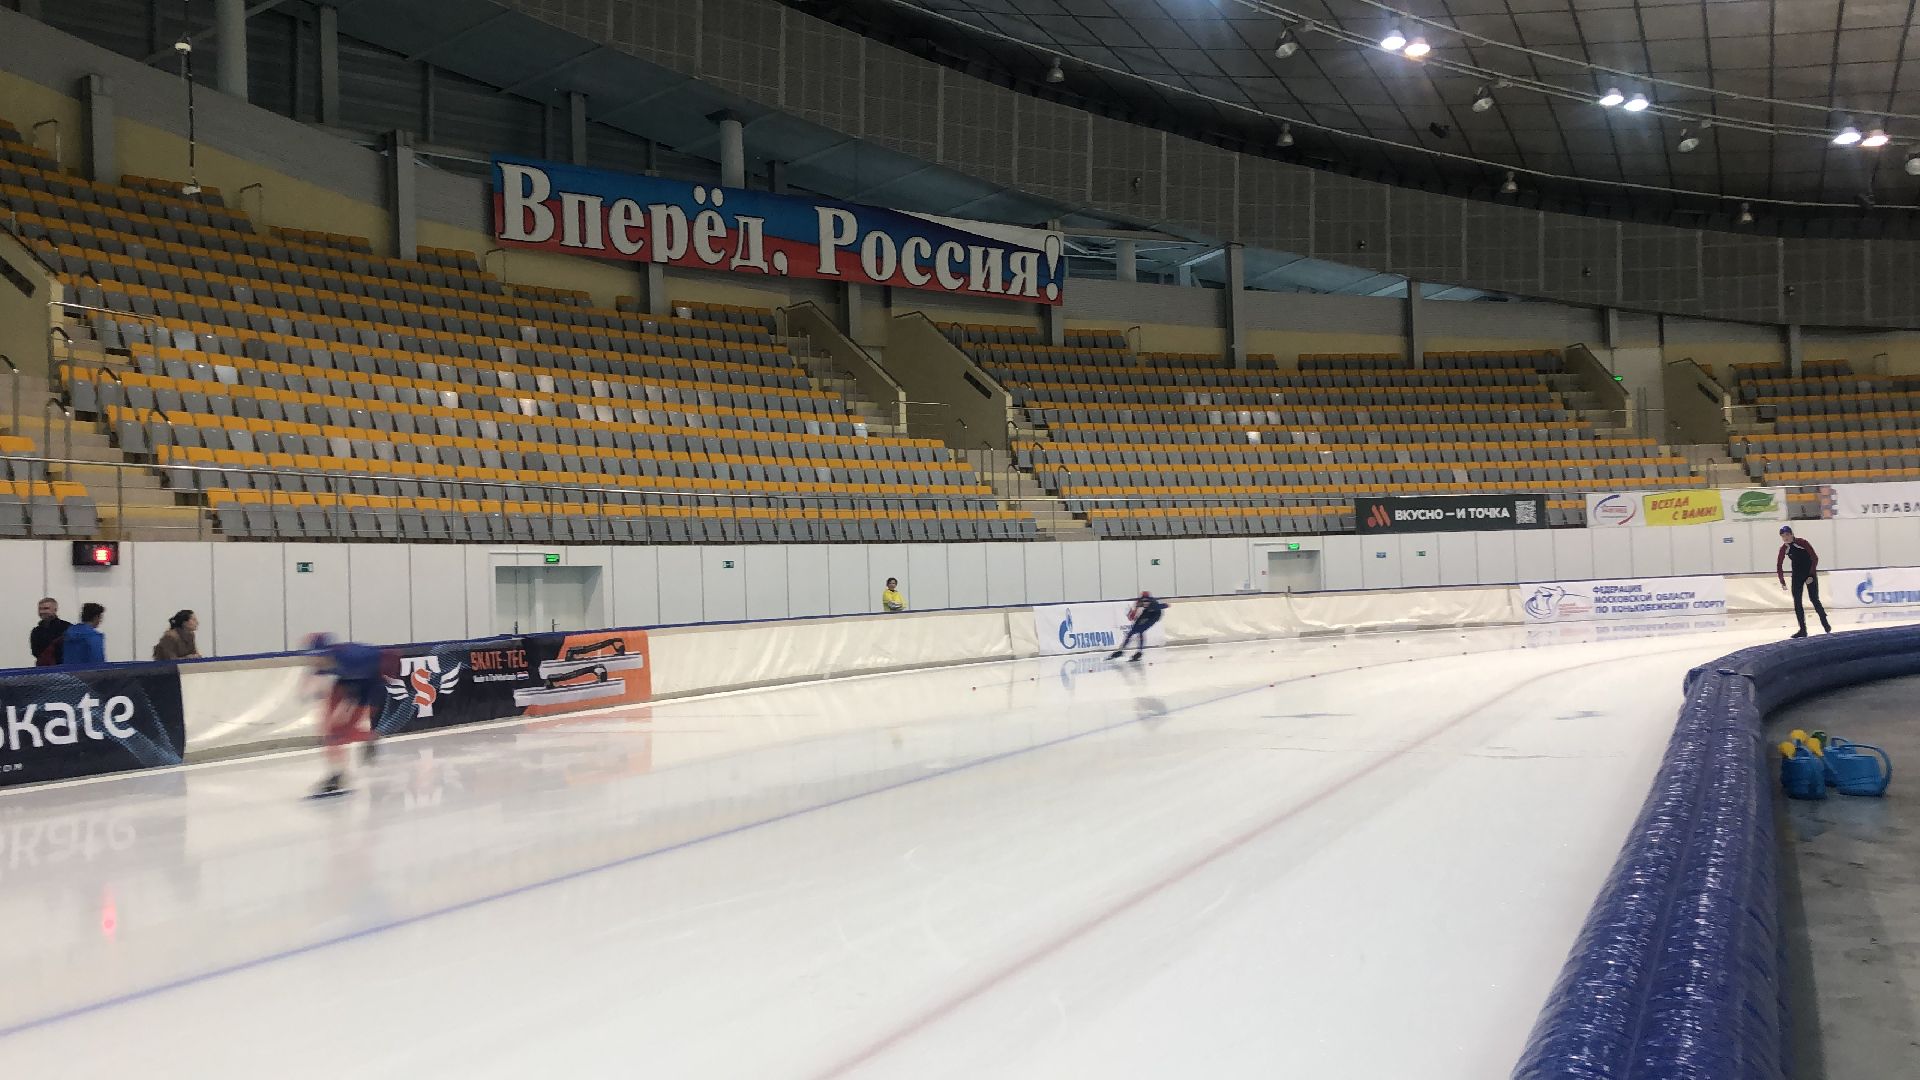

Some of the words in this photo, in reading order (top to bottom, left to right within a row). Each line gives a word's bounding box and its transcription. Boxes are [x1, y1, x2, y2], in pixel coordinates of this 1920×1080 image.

[814, 205, 1061, 301] Россия!
[1651, 496, 1689, 511] ВСЕГДА
[1395, 508, 1444, 521] ВКУСНО
[1456, 508, 1466, 519] И
[1468, 507, 1510, 519] ТОЧКА
[1682, 505, 1718, 519] ВАМИ!
[1592, 584, 1642, 594] ФЕДЕРАЦИЯ
[1594, 592, 1652, 603] МОСКОВСКОЙ
[1656, 591, 1695, 601] ОБЛАСТИ
[1595, 605, 1609, 614] ПО
[1611, 602, 1689, 613] КОНЬКОБЕЖНОМУ
[1693, 600, 1726, 609] СПОРТУ
[1076, 630, 1115, 649] ГАЗПРОМ
[0, 692, 136, 751] kate
